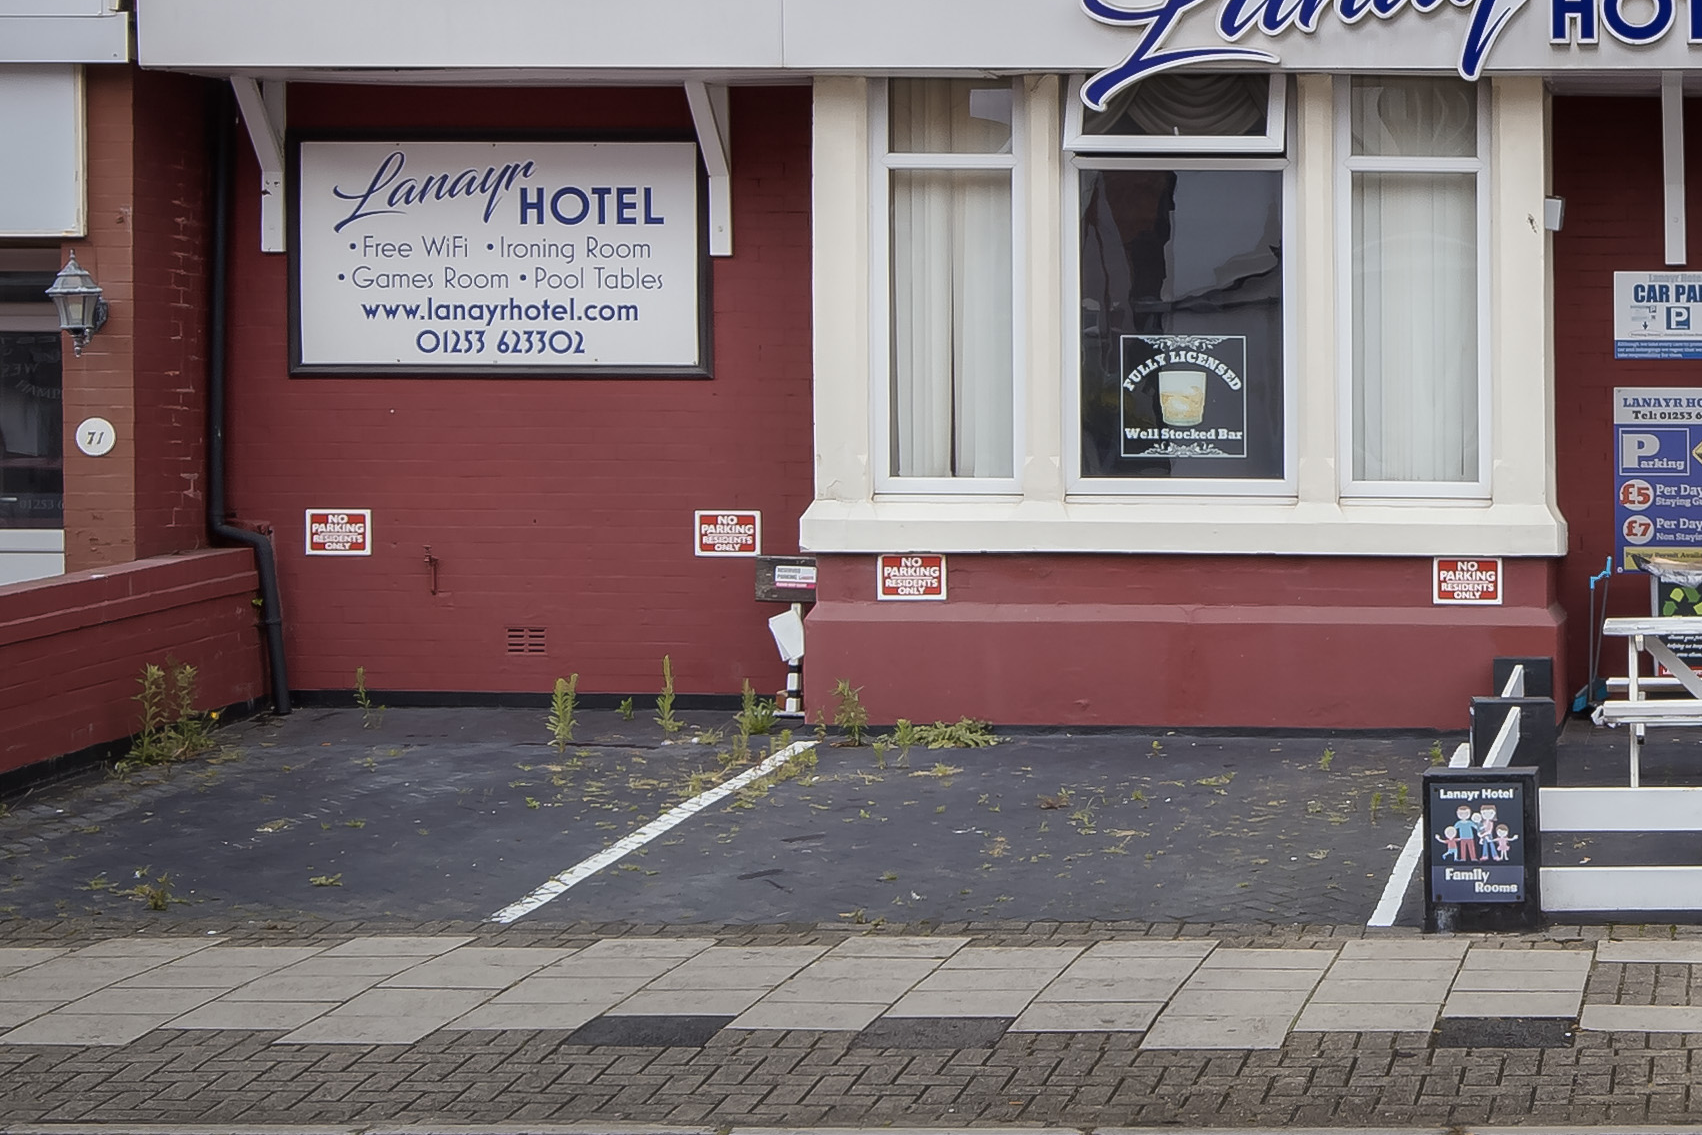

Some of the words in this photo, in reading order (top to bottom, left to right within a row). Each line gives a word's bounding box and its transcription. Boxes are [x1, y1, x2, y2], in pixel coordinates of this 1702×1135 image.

[333, 151, 535, 233] Lanayr
[519, 186, 665, 226] HOTEL
[362, 236, 413, 259] Free
[421, 236, 469, 259] WiFi
[500, 236, 576, 264] Ironing
[585, 236, 652, 259] Room
[352, 267, 434, 290] Games
[444, 267, 509, 290] Room
[534, 267, 585, 290] Pool
[594, 267, 664, 290] Tables
[1633, 284, 1670, 303] CAR
[361, 297, 639, 327] www.lanayrhotel.com
[416, 330, 486, 354] 01253
[497, 330, 586, 354] 623302
[1122, 352, 1167, 392] FULLY
[1169, 350, 1242, 391] LICENSED
[1623, 397, 1685, 408] LANAYR
[1632, 410, 1657, 420] Tel:
[1659, 411, 1694, 420] 01253
[87, 432, 104, 445] 71
[1125, 428, 1160, 439] Well
[1160, 428, 1216, 440] Stocked
[1217, 428, 1243, 440] Bar
[1622, 433, 1685, 470] Parking
[1619, 483, 1650, 506] £5
[1656, 484, 1677, 496] Per
[1655, 497, 1691, 507] Staying
[327, 514, 348, 523] NO
[717, 516, 738, 525] NO
[1656, 518, 1677, 529] Per
[311, 523, 365, 533] PARKING
[701, 524, 754, 534] PARKING
[1625, 520, 1652, 537] £7
[312, 535, 364, 543] RESIDENTS
[702, 536, 753, 544] RESIDENTS
[1656, 532, 1674, 541] Non
[324, 542, 351, 550] ONLY
[901, 557, 922, 567] NO
[1457, 561, 1478, 571] NO
[883, 567, 940, 577] PARKING
[1439, 570, 1496, 581] PARKING
[885, 579, 938, 587] RESIDENTS
[1441, 583, 1494, 591] RESIDENTS
[897, 587, 926, 595] ONLY
[1453, 591, 1481, 599] ONLY
[1439, 788, 1480, 801] Lanayr
[1481, 788, 1514, 799] Hotel
[1445, 868, 1490, 883] Family
[1474, 882, 1518, 893] Rooms
